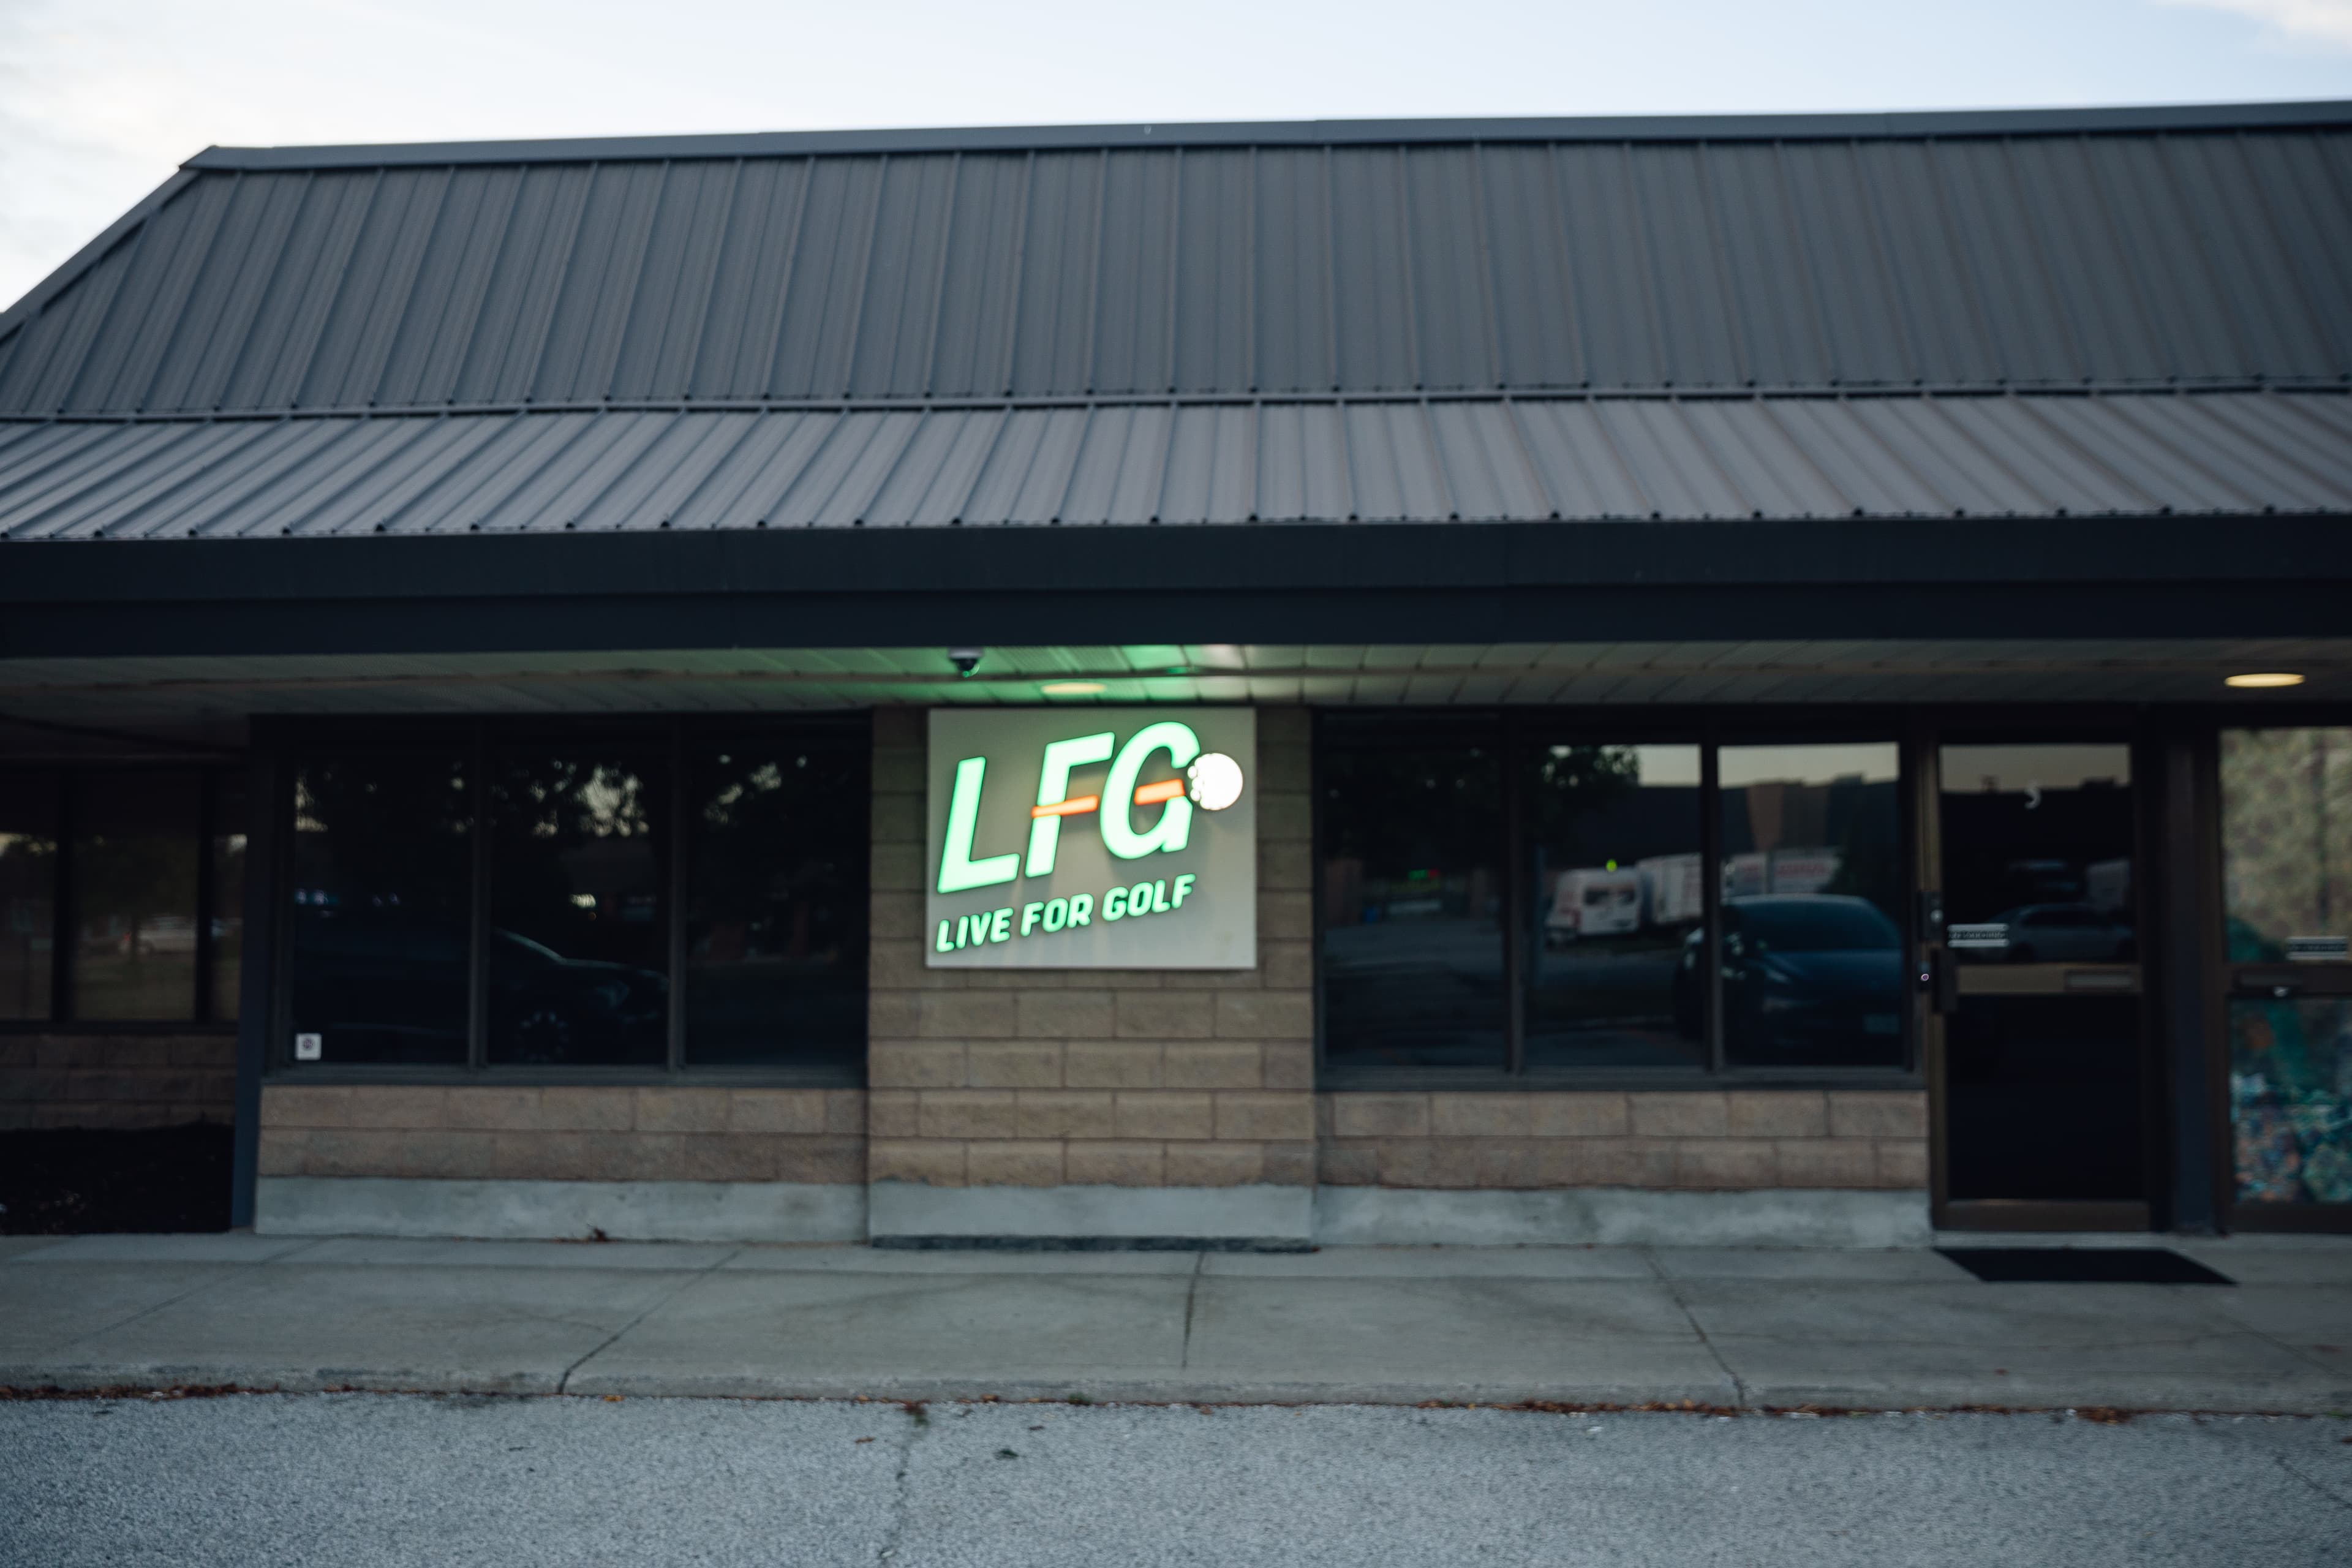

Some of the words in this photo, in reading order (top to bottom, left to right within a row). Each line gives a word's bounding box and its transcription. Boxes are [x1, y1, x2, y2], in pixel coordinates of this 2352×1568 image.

[937, 721, 1200, 894] LFG
[935, 907, 1014, 953] LIVE
[1020, 892, 1095, 937] FOR
[1101, 873, 1196, 922] GOLF
